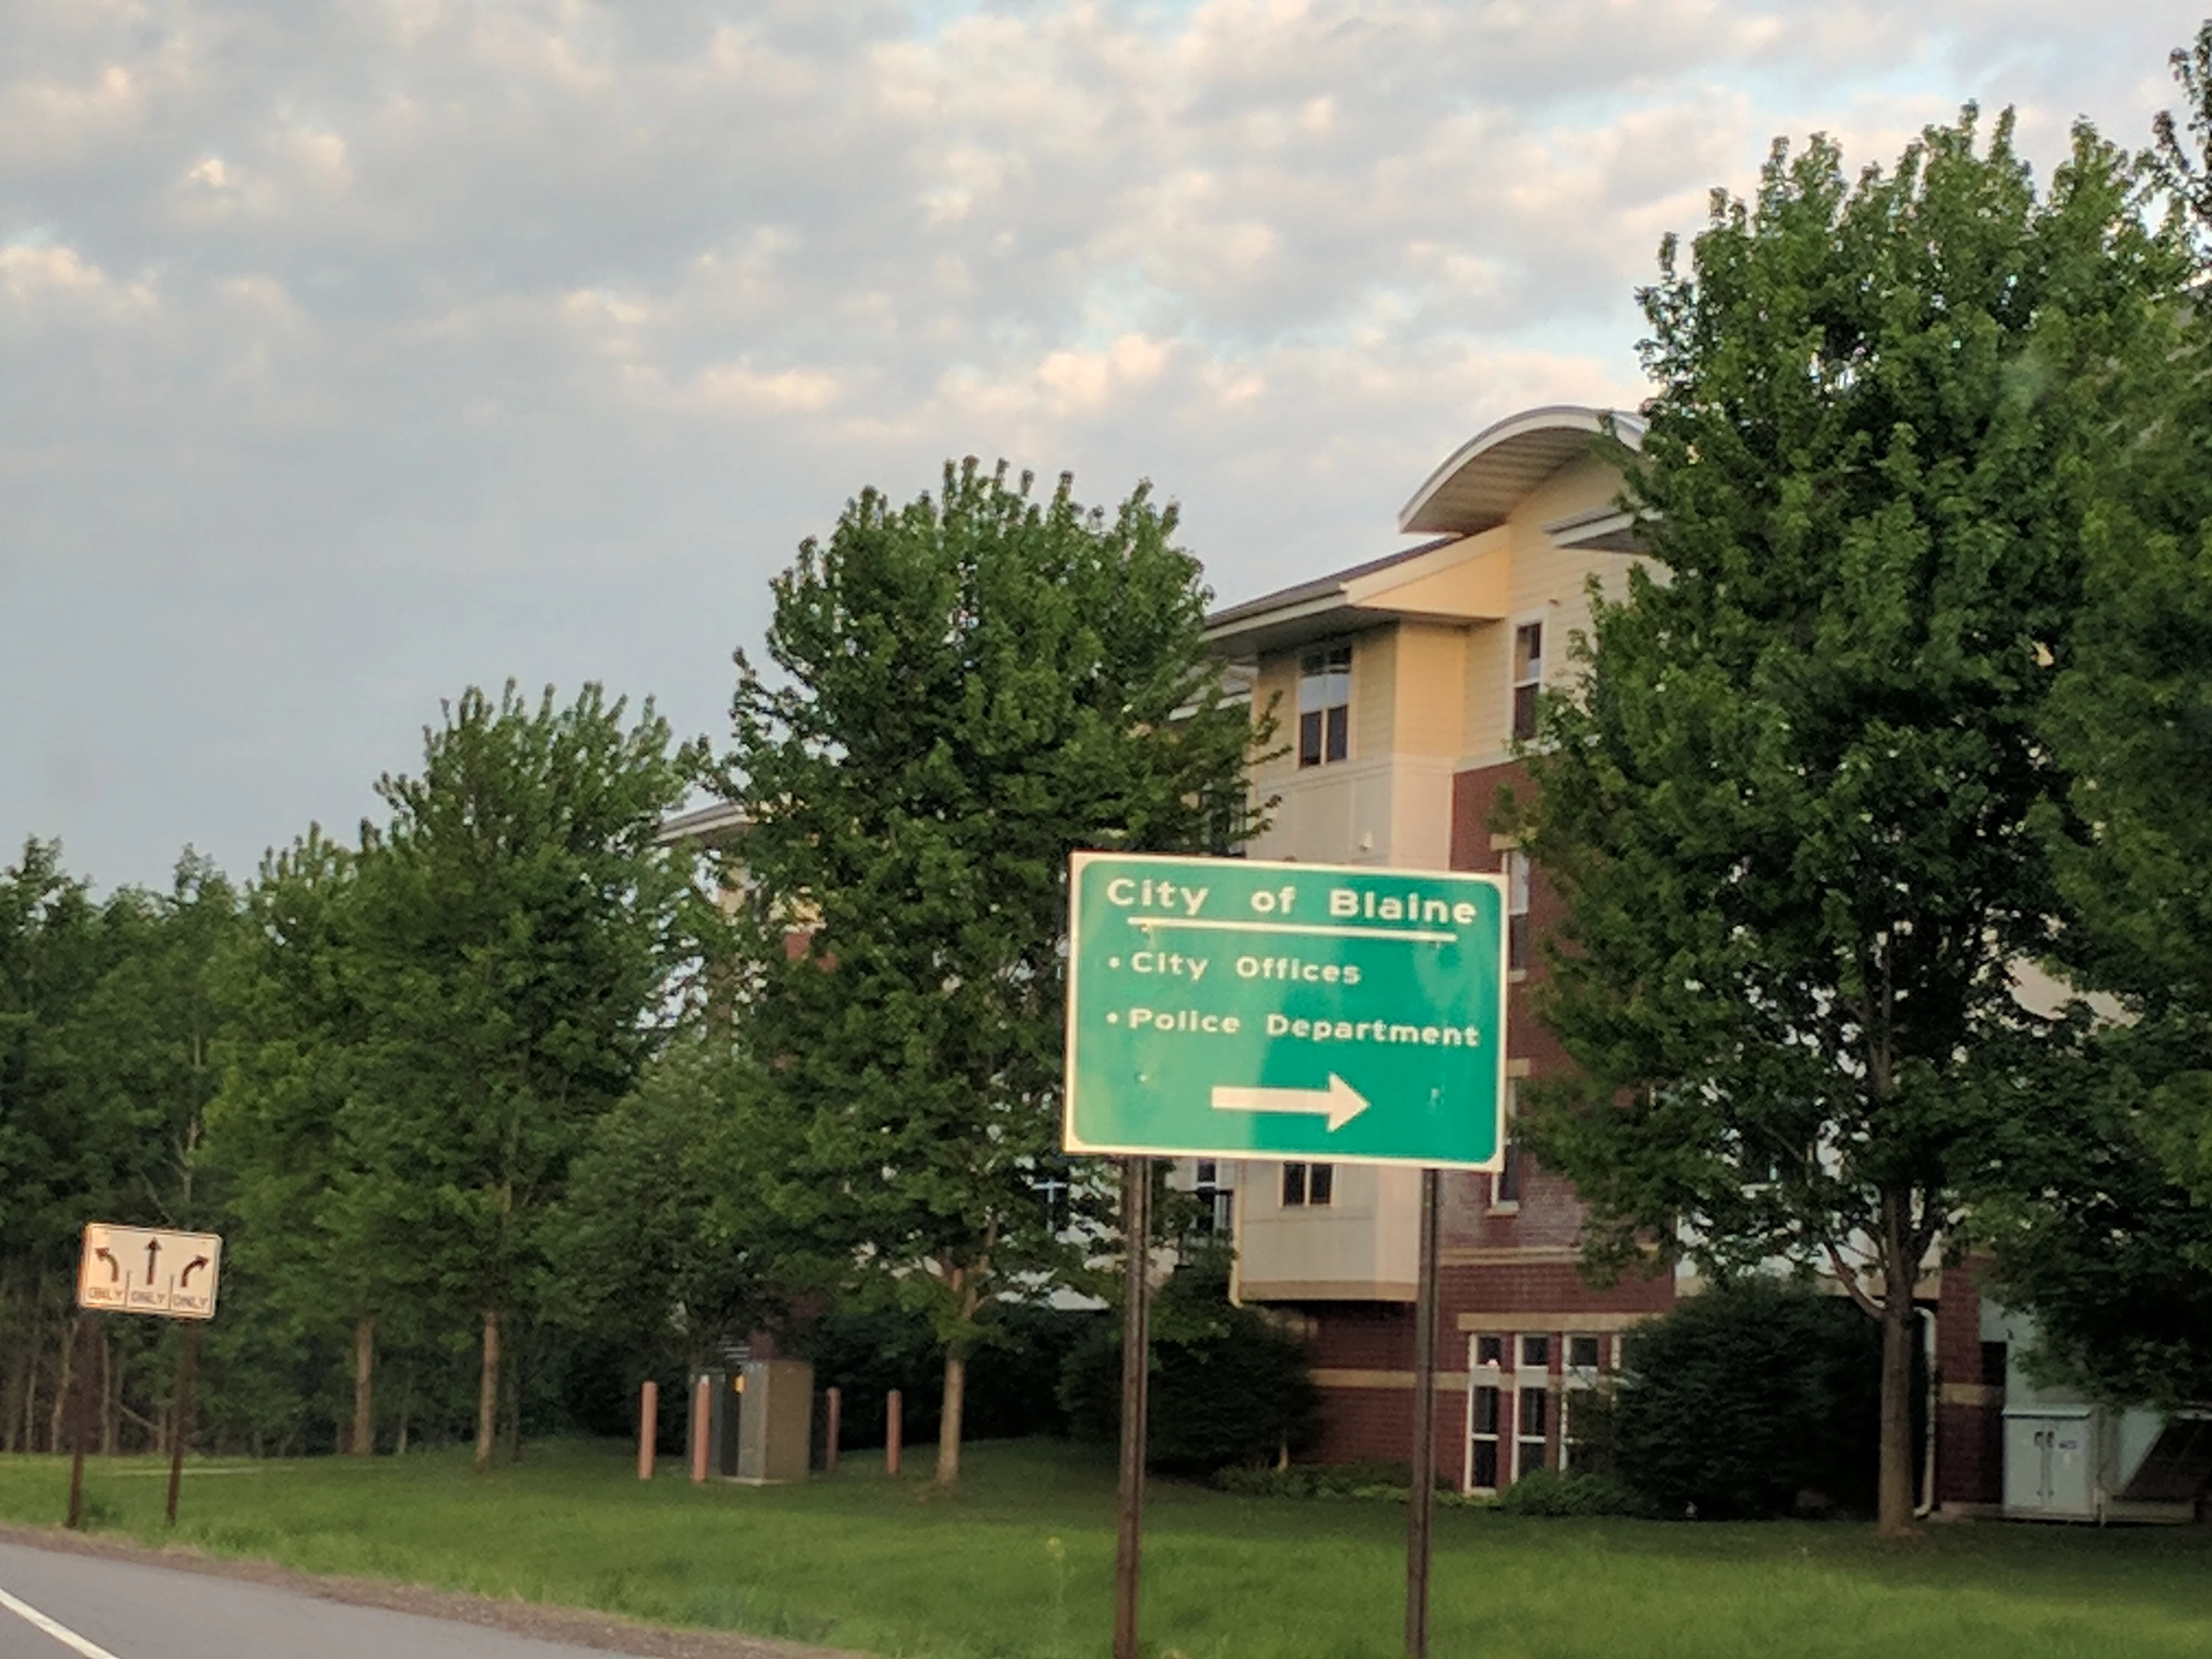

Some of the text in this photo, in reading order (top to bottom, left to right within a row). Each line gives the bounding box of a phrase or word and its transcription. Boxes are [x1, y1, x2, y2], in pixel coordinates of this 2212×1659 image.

[1107, 878, 1476, 924] City of Blaine
[1131, 951, 1361, 984] City Offices
[1128, 1008, 1479, 1047] Police Department
